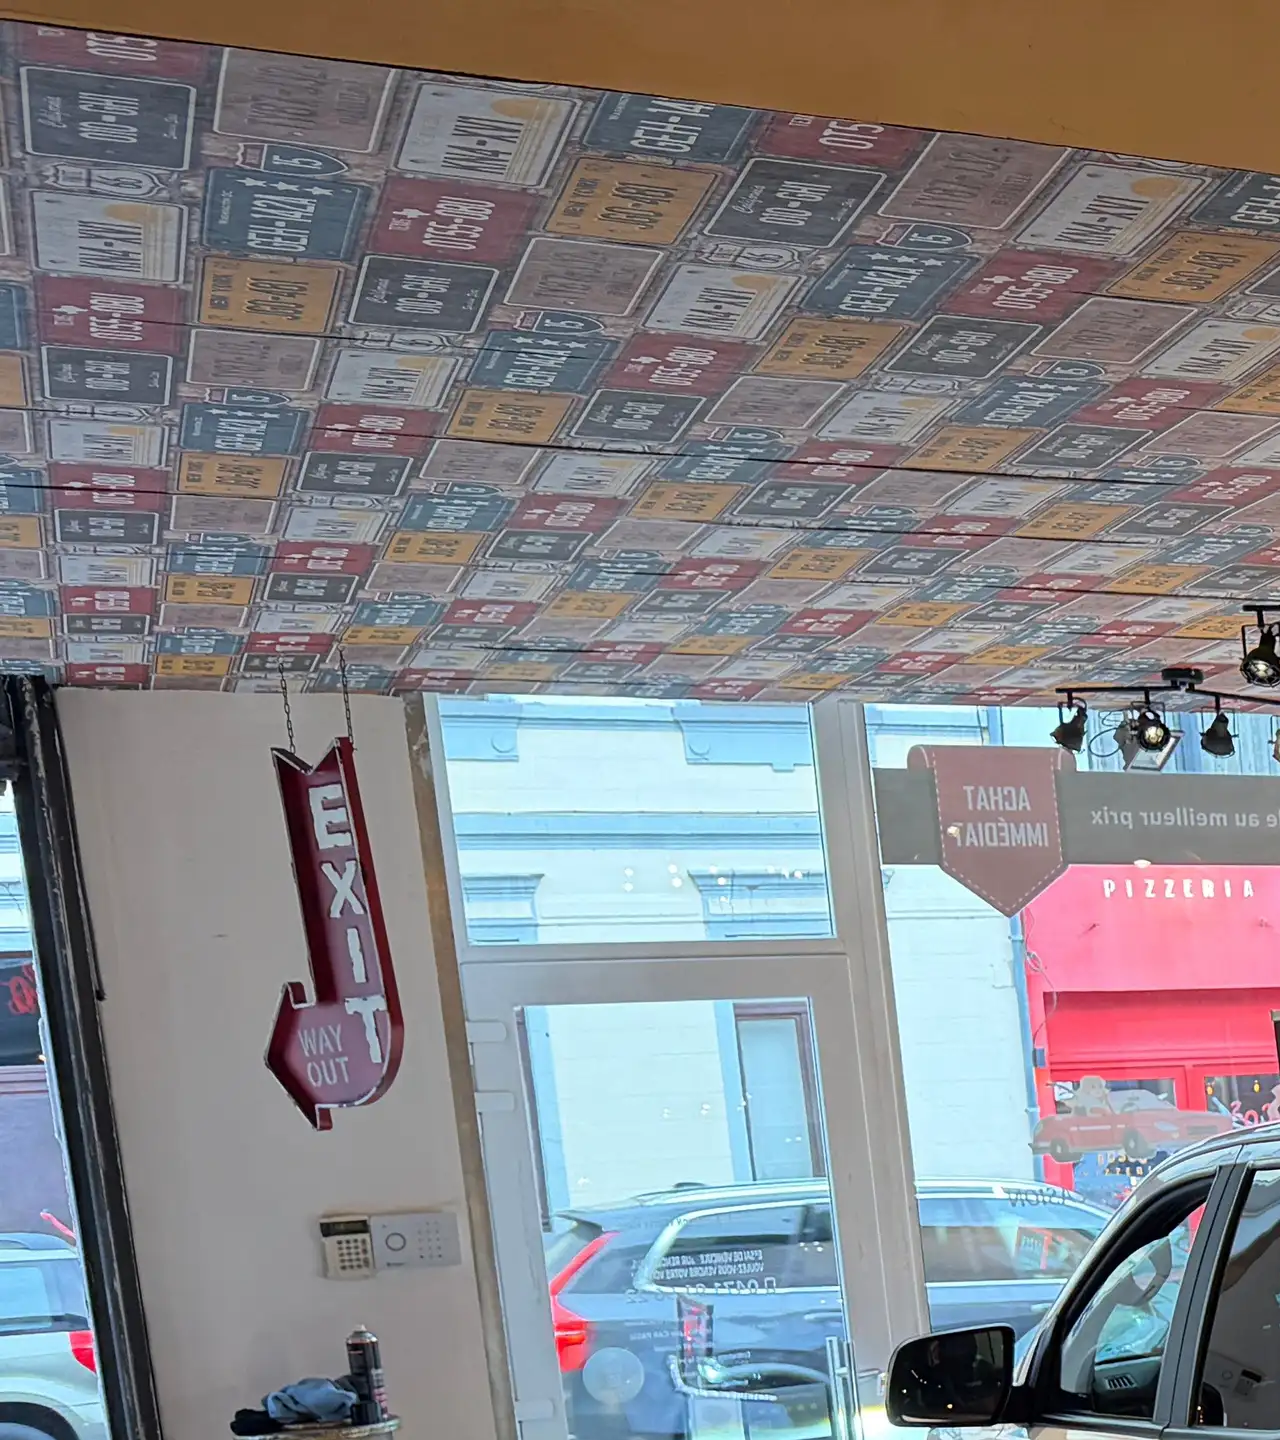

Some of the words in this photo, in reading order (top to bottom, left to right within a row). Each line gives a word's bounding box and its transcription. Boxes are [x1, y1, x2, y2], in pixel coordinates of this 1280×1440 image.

[1103, 879, 1254, 899] PIZZERIA
[308, 782, 388, 1065] EXIT
[299, 1024, 343, 1056] WAY
[307, 1056, 351, 1087] OUT
